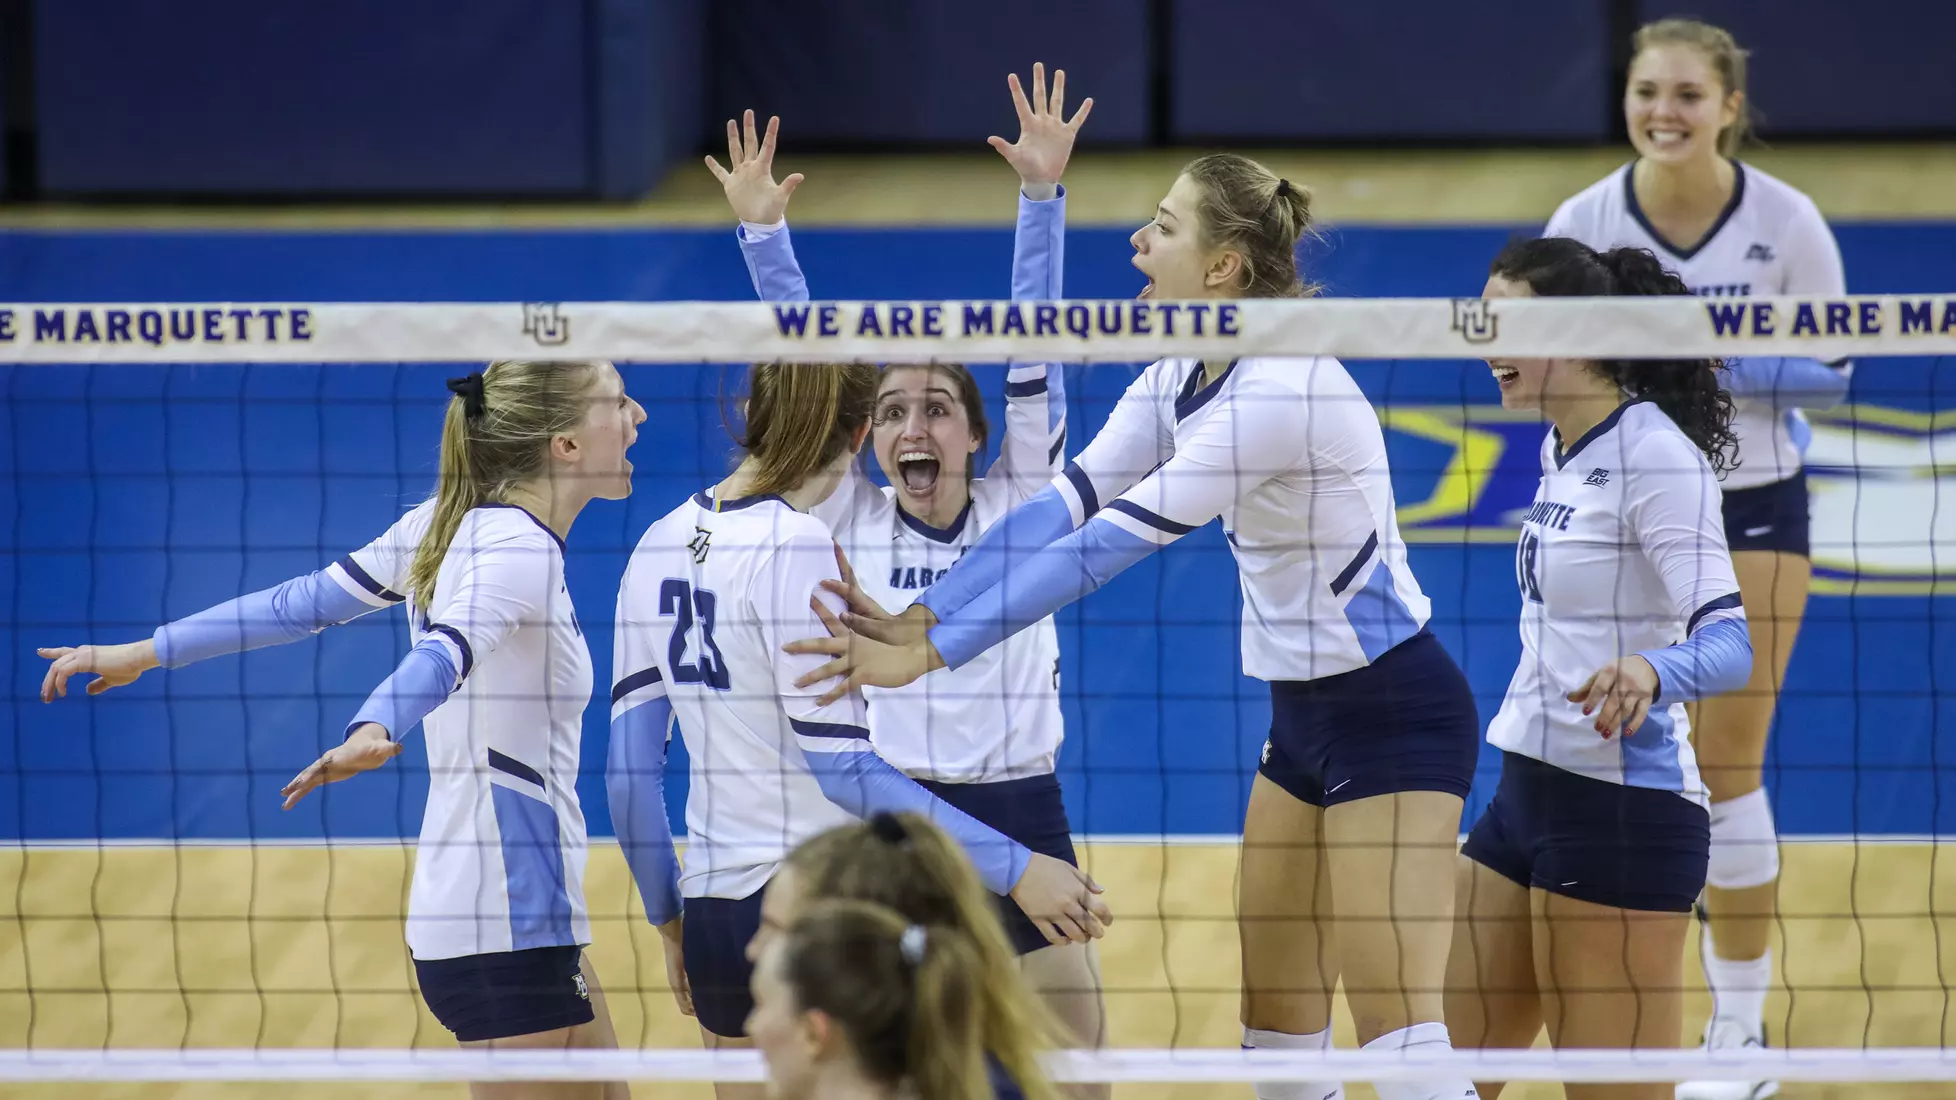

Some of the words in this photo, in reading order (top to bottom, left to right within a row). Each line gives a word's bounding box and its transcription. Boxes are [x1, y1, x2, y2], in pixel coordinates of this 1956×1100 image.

[33, 308, 313, 345] MARQUETTE
[774, 304, 840, 337] WE
[855, 304, 943, 337] ARE
[961, 302, 1241, 339] MARQUETTE
[1706, 302, 1775, 335] WE
[1791, 302, 1881, 335] ARE
[1585, 474, 1611, 486] EAST
[1591, 467, 1610, 478] BIG
[1518, 528, 1544, 605] 18
[658, 576, 732, 691] 23
